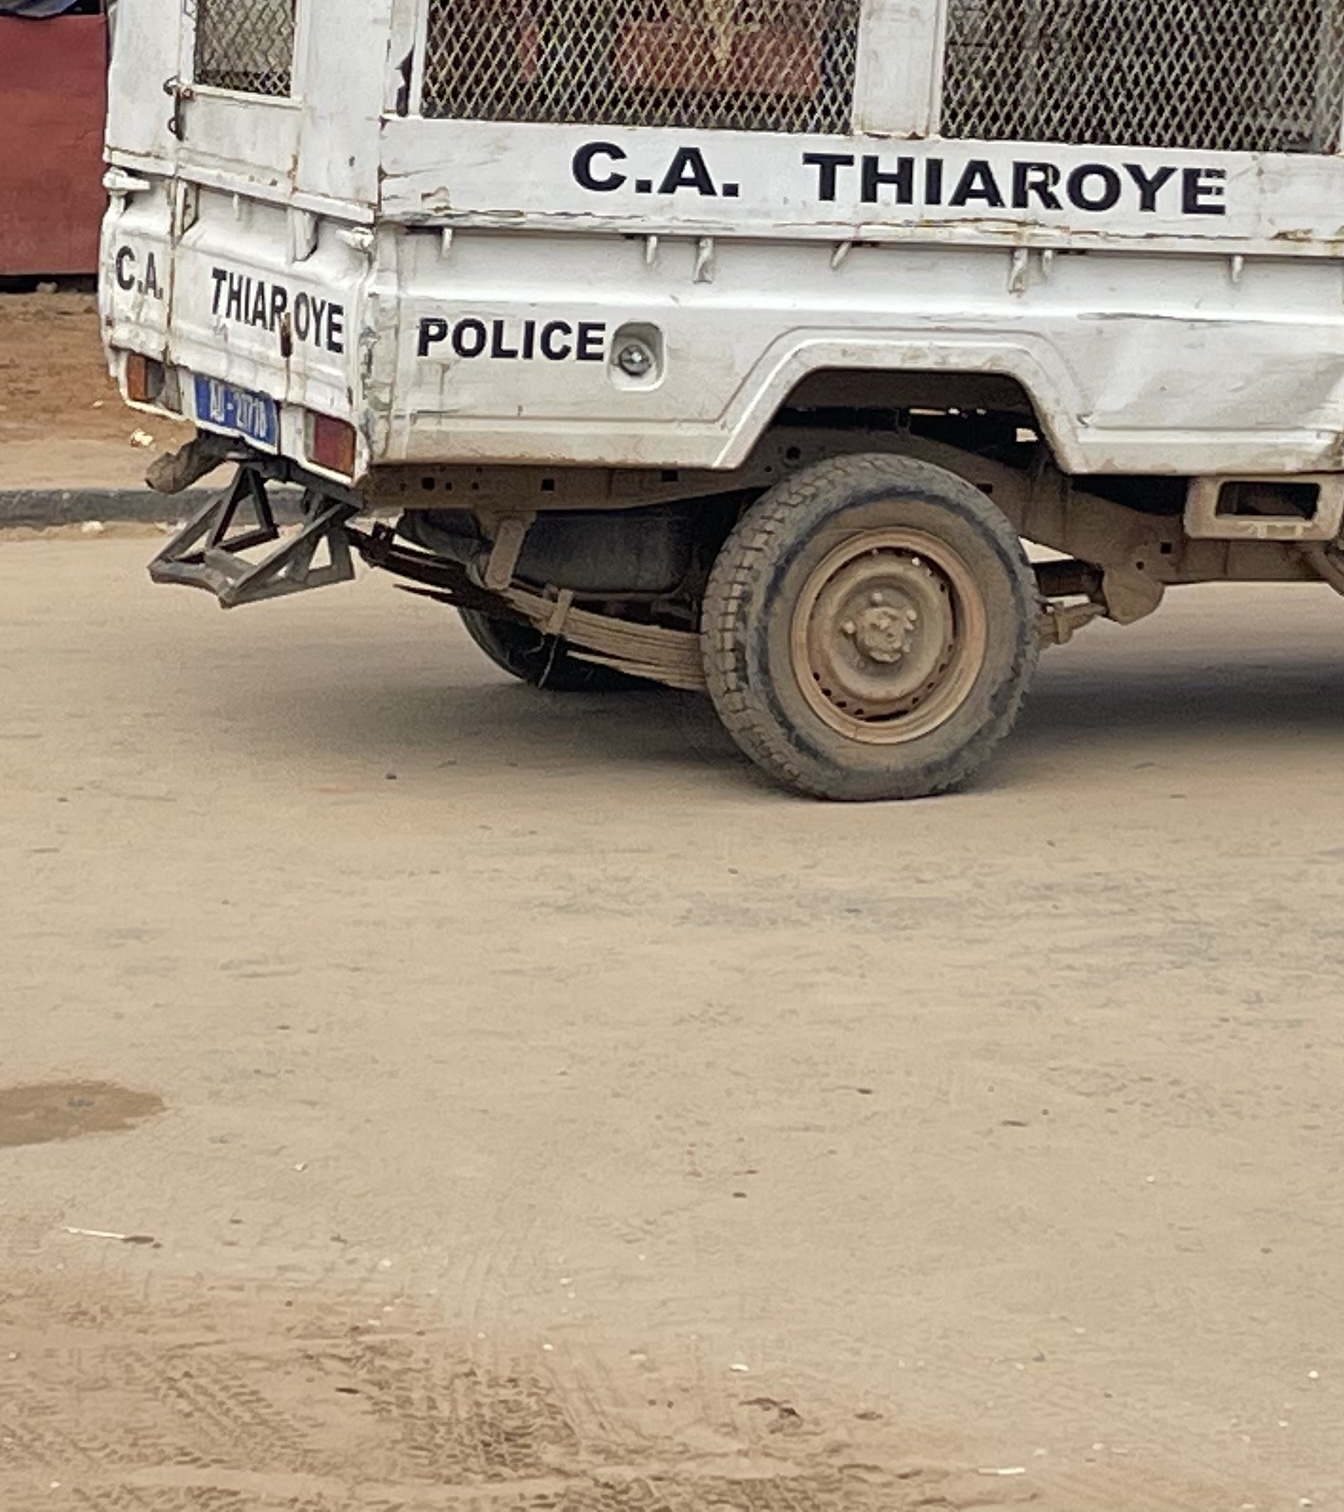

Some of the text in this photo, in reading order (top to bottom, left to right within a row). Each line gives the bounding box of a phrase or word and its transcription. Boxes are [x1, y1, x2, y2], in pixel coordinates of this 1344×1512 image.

[571, 141, 1229, 216] C.A. THIAROYE
[115, 245, 346, 355] C.A. THIAROYE
[416, 317, 607, 362] POLICE
